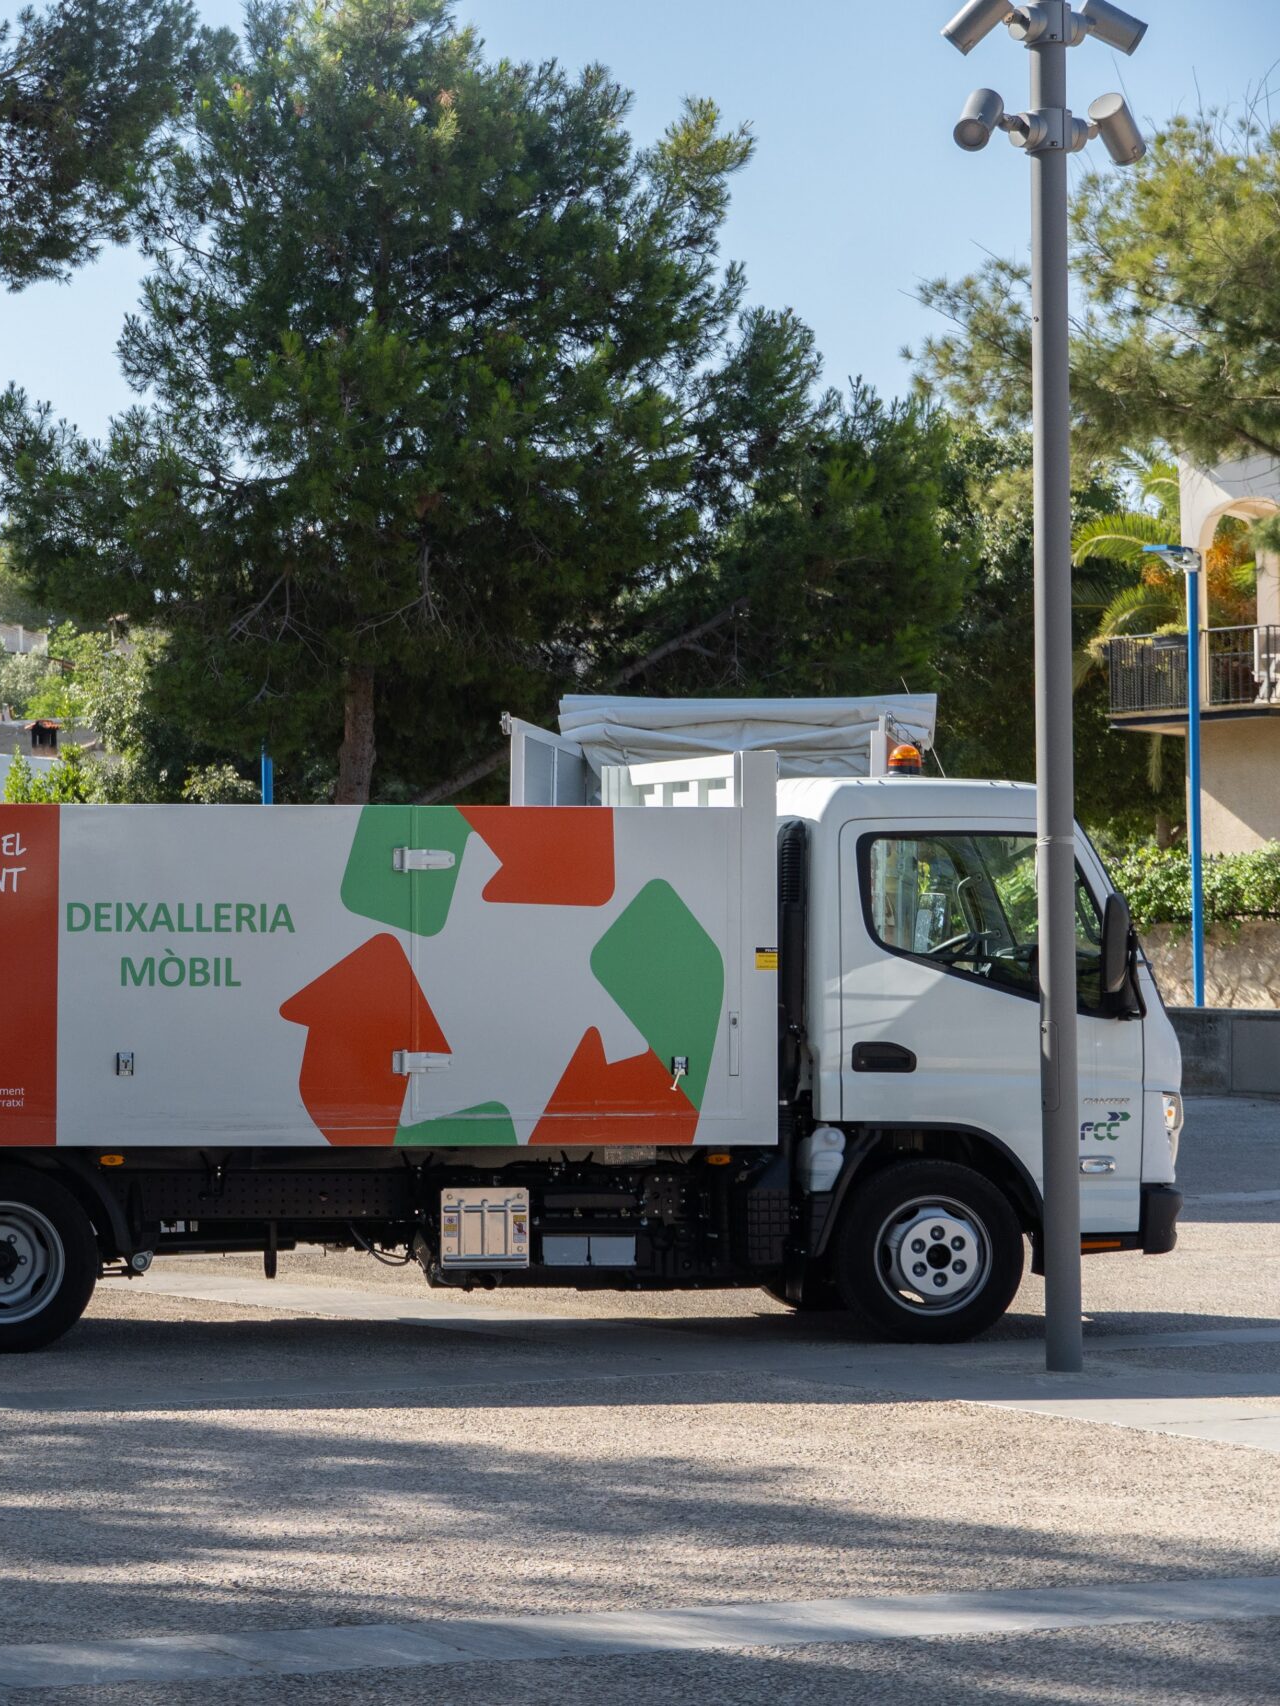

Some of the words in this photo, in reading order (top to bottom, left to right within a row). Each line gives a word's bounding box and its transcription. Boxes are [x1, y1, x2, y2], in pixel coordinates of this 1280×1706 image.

[1, 832, 27, 856] EL
[66, 902, 296, 933] DEIXALLERIA
[120, 948, 242, 987] MÒBIL
